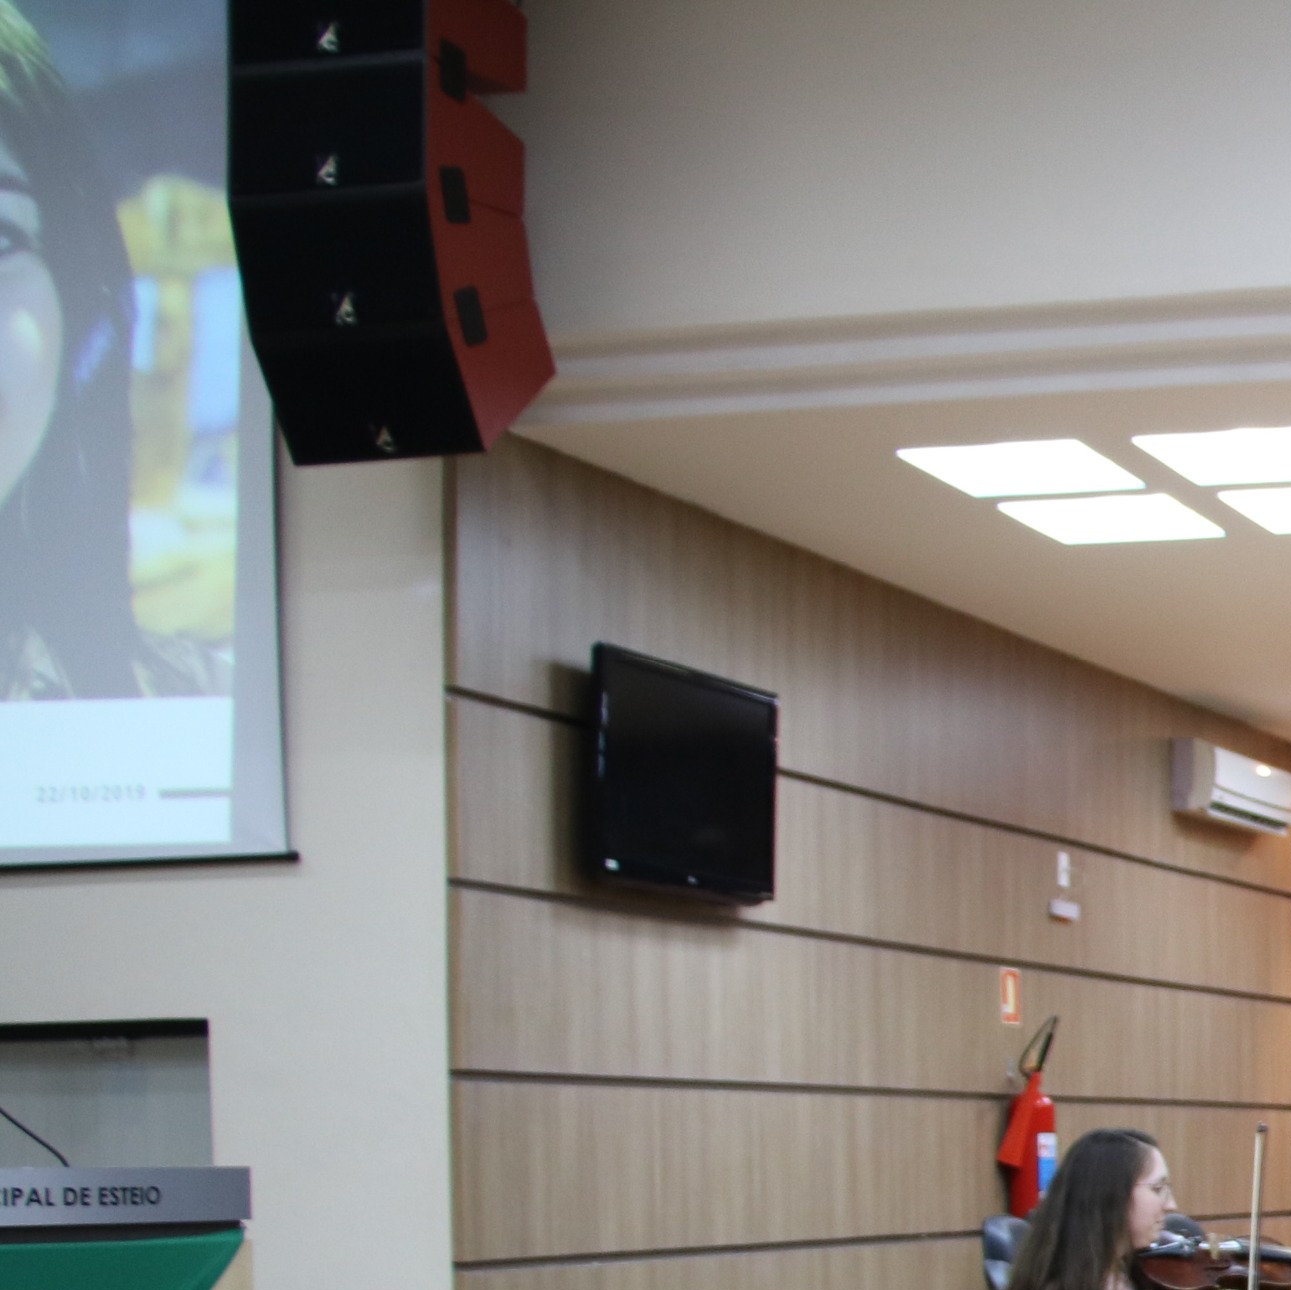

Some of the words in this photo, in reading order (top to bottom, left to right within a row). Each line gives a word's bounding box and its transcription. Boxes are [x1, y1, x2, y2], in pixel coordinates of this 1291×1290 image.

[0, 1187, 55, 1206] IPAL
[63, 1187, 91, 1206] DE
[99, 1186, 161, 1206] ESTEIO
